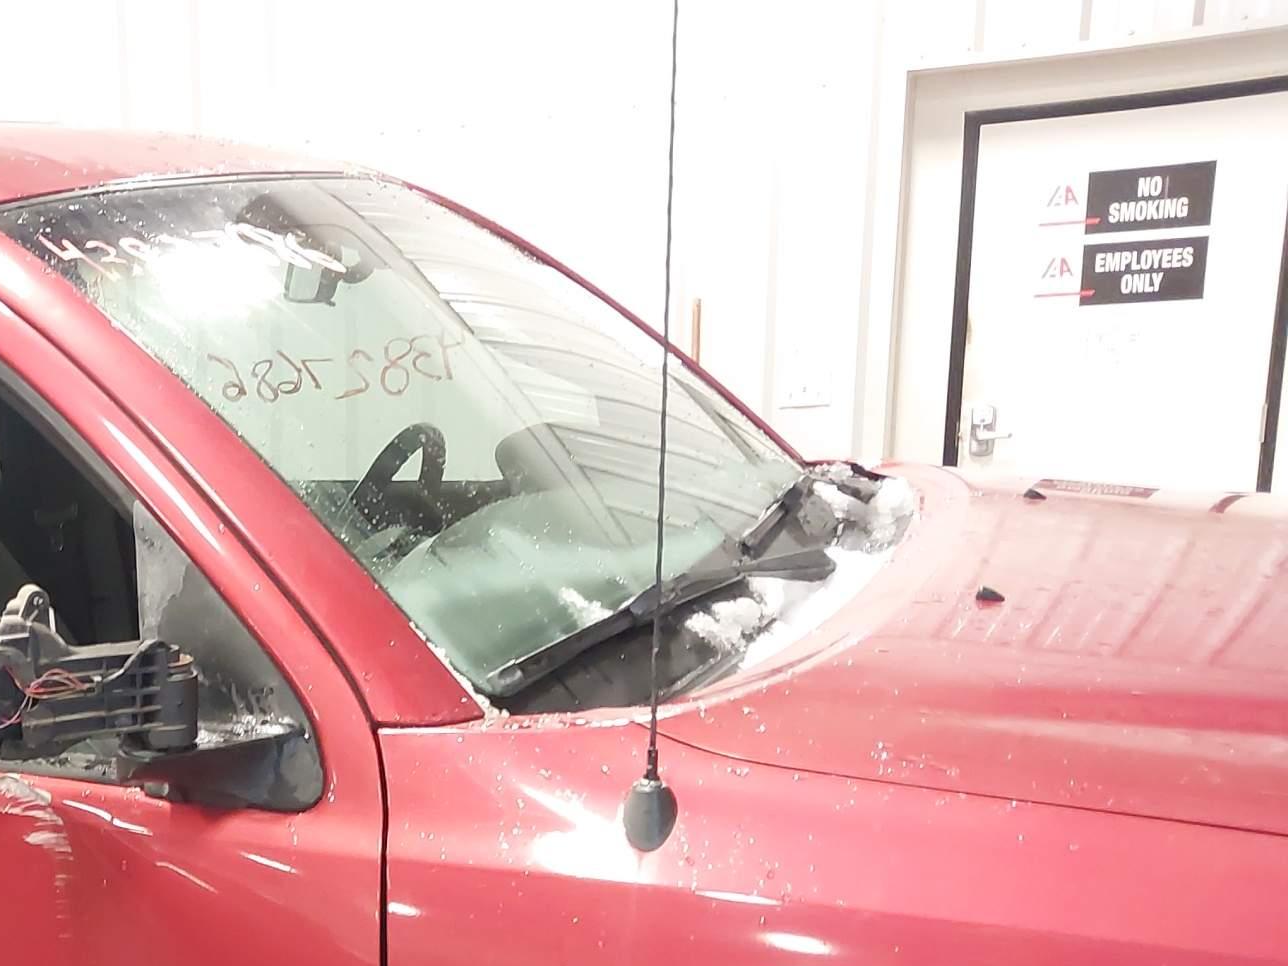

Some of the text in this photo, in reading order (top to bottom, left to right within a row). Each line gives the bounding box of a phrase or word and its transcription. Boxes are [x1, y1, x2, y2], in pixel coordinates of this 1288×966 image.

[1137, 175, 1163, 198] NO
[1107, 196, 1190, 225] SMOKING
[1094, 246, 1195, 274] EMPLOYEES
[1120, 272, 1164, 295] ONLY
